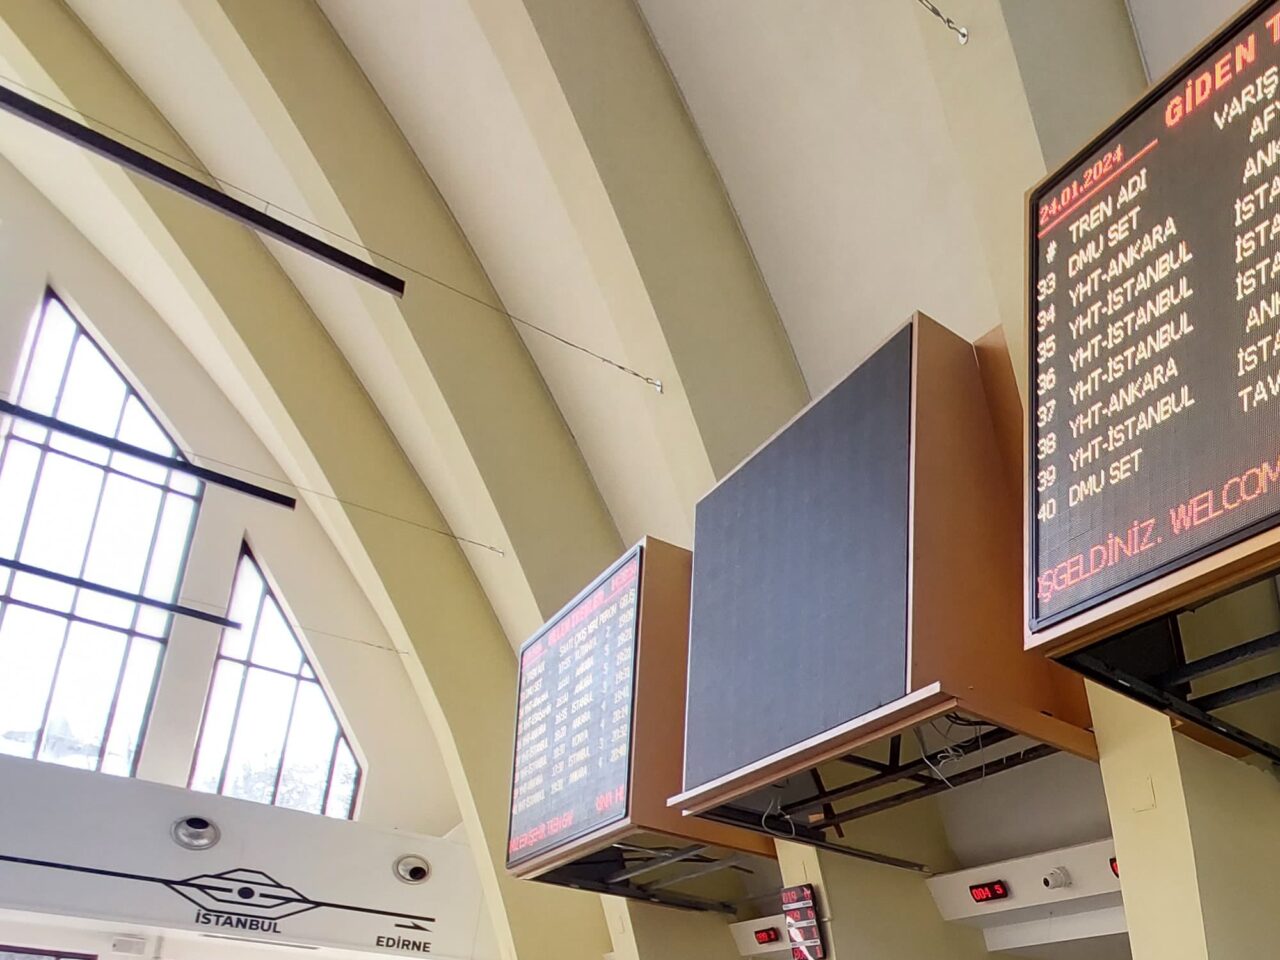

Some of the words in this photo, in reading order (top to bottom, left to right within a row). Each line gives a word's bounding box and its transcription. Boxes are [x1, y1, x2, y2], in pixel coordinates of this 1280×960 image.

[1165, 33, 1256, 128] GİDEN
[1039, 144, 1125, 226] 24.01.2024
[1068, 195, 1112, 243] TREN
[1117, 168, 1147, 209] ADI
[1037, 272, 1056, 302] 33
[1068, 234, 1104, 278] DMU
[1108, 206, 1141, 247] SET
[1037, 304, 1056, 333] 34
[1037, 335, 1056, 364] 35
[1037, 367, 1056, 396] 36
[1037, 400, 1056, 428] 37
[1037, 432, 1056, 460] 38
[1037, 465, 1056, 494] 39
[1037, 498, 1056, 523] 40
[1068, 477, 1105, 507] DMU
[1109, 448, 1143, 485] SET
[972, 887, 991, 900] 004
[994, 884, 1003, 895] 5
[195, 909, 281, 934] İSTANBUL
[375, 936, 432, 952] EDİRNE
